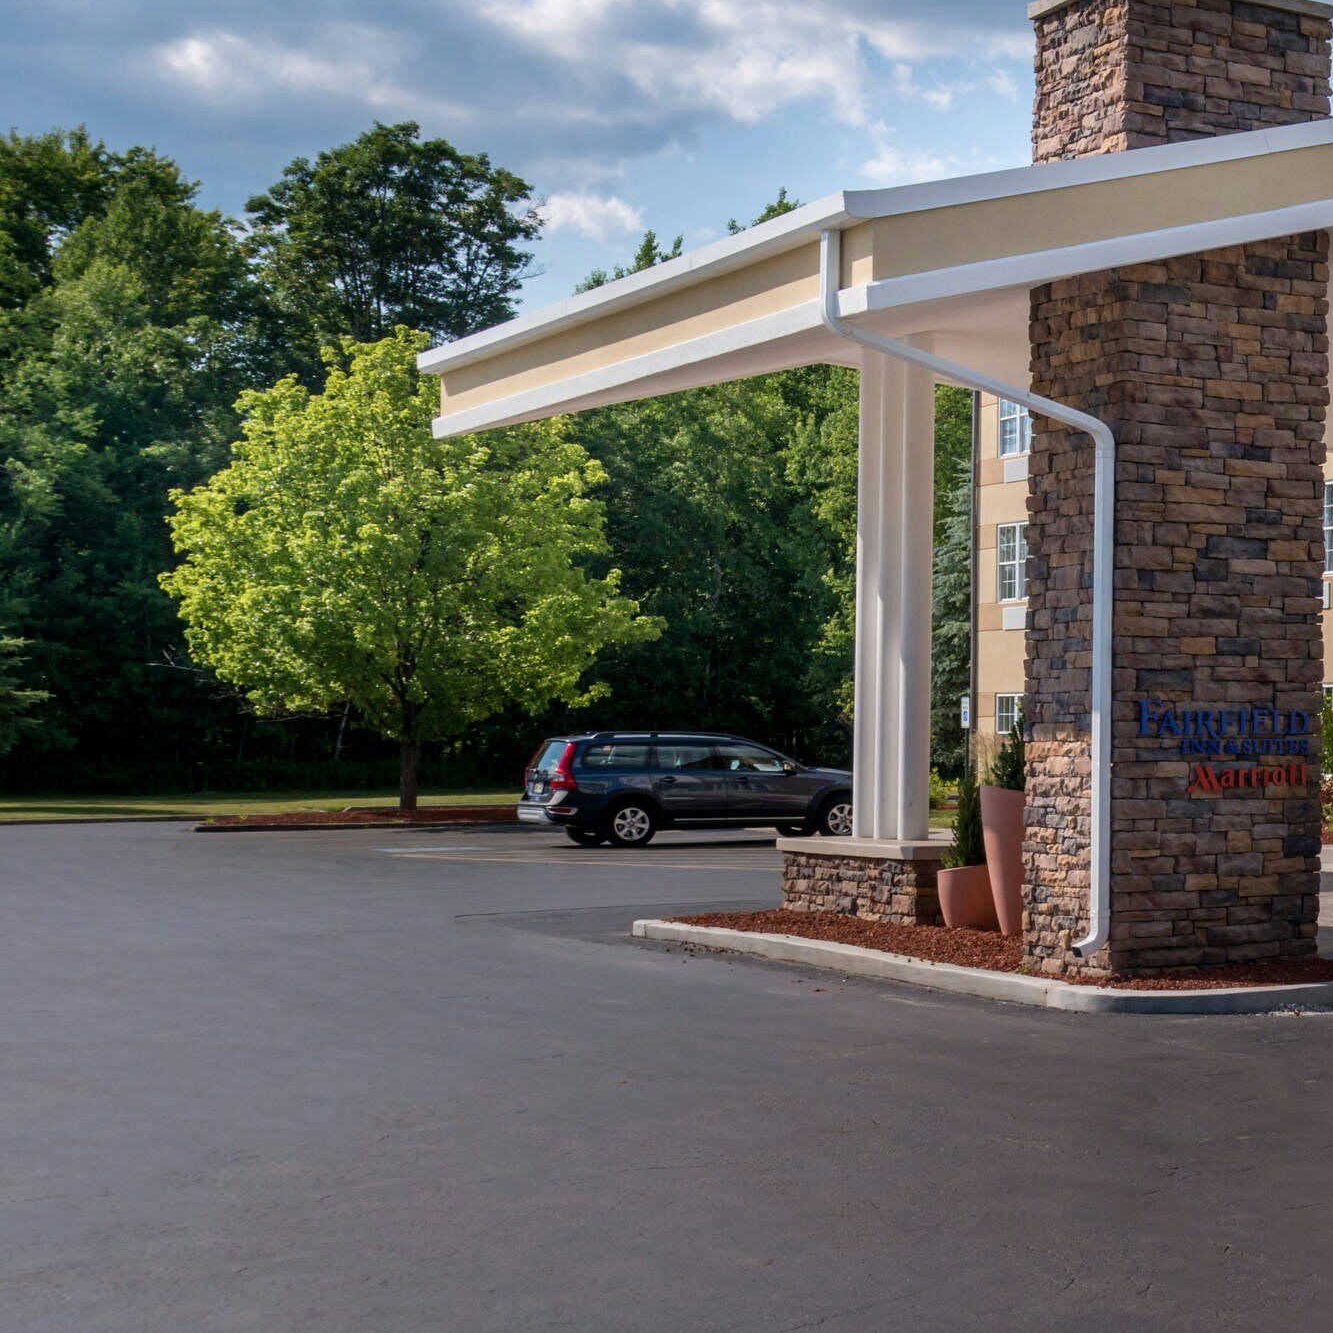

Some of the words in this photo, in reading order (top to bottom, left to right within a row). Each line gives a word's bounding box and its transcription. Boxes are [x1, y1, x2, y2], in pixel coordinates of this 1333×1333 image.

[1137, 699, 1310, 738] FAIRFIELD
[1180, 739, 1221, 755] INN
[1224, 739, 1239, 755] &
[1241, 739, 1310, 755] SUITES
[1186, 763, 1307, 794] Marriott
